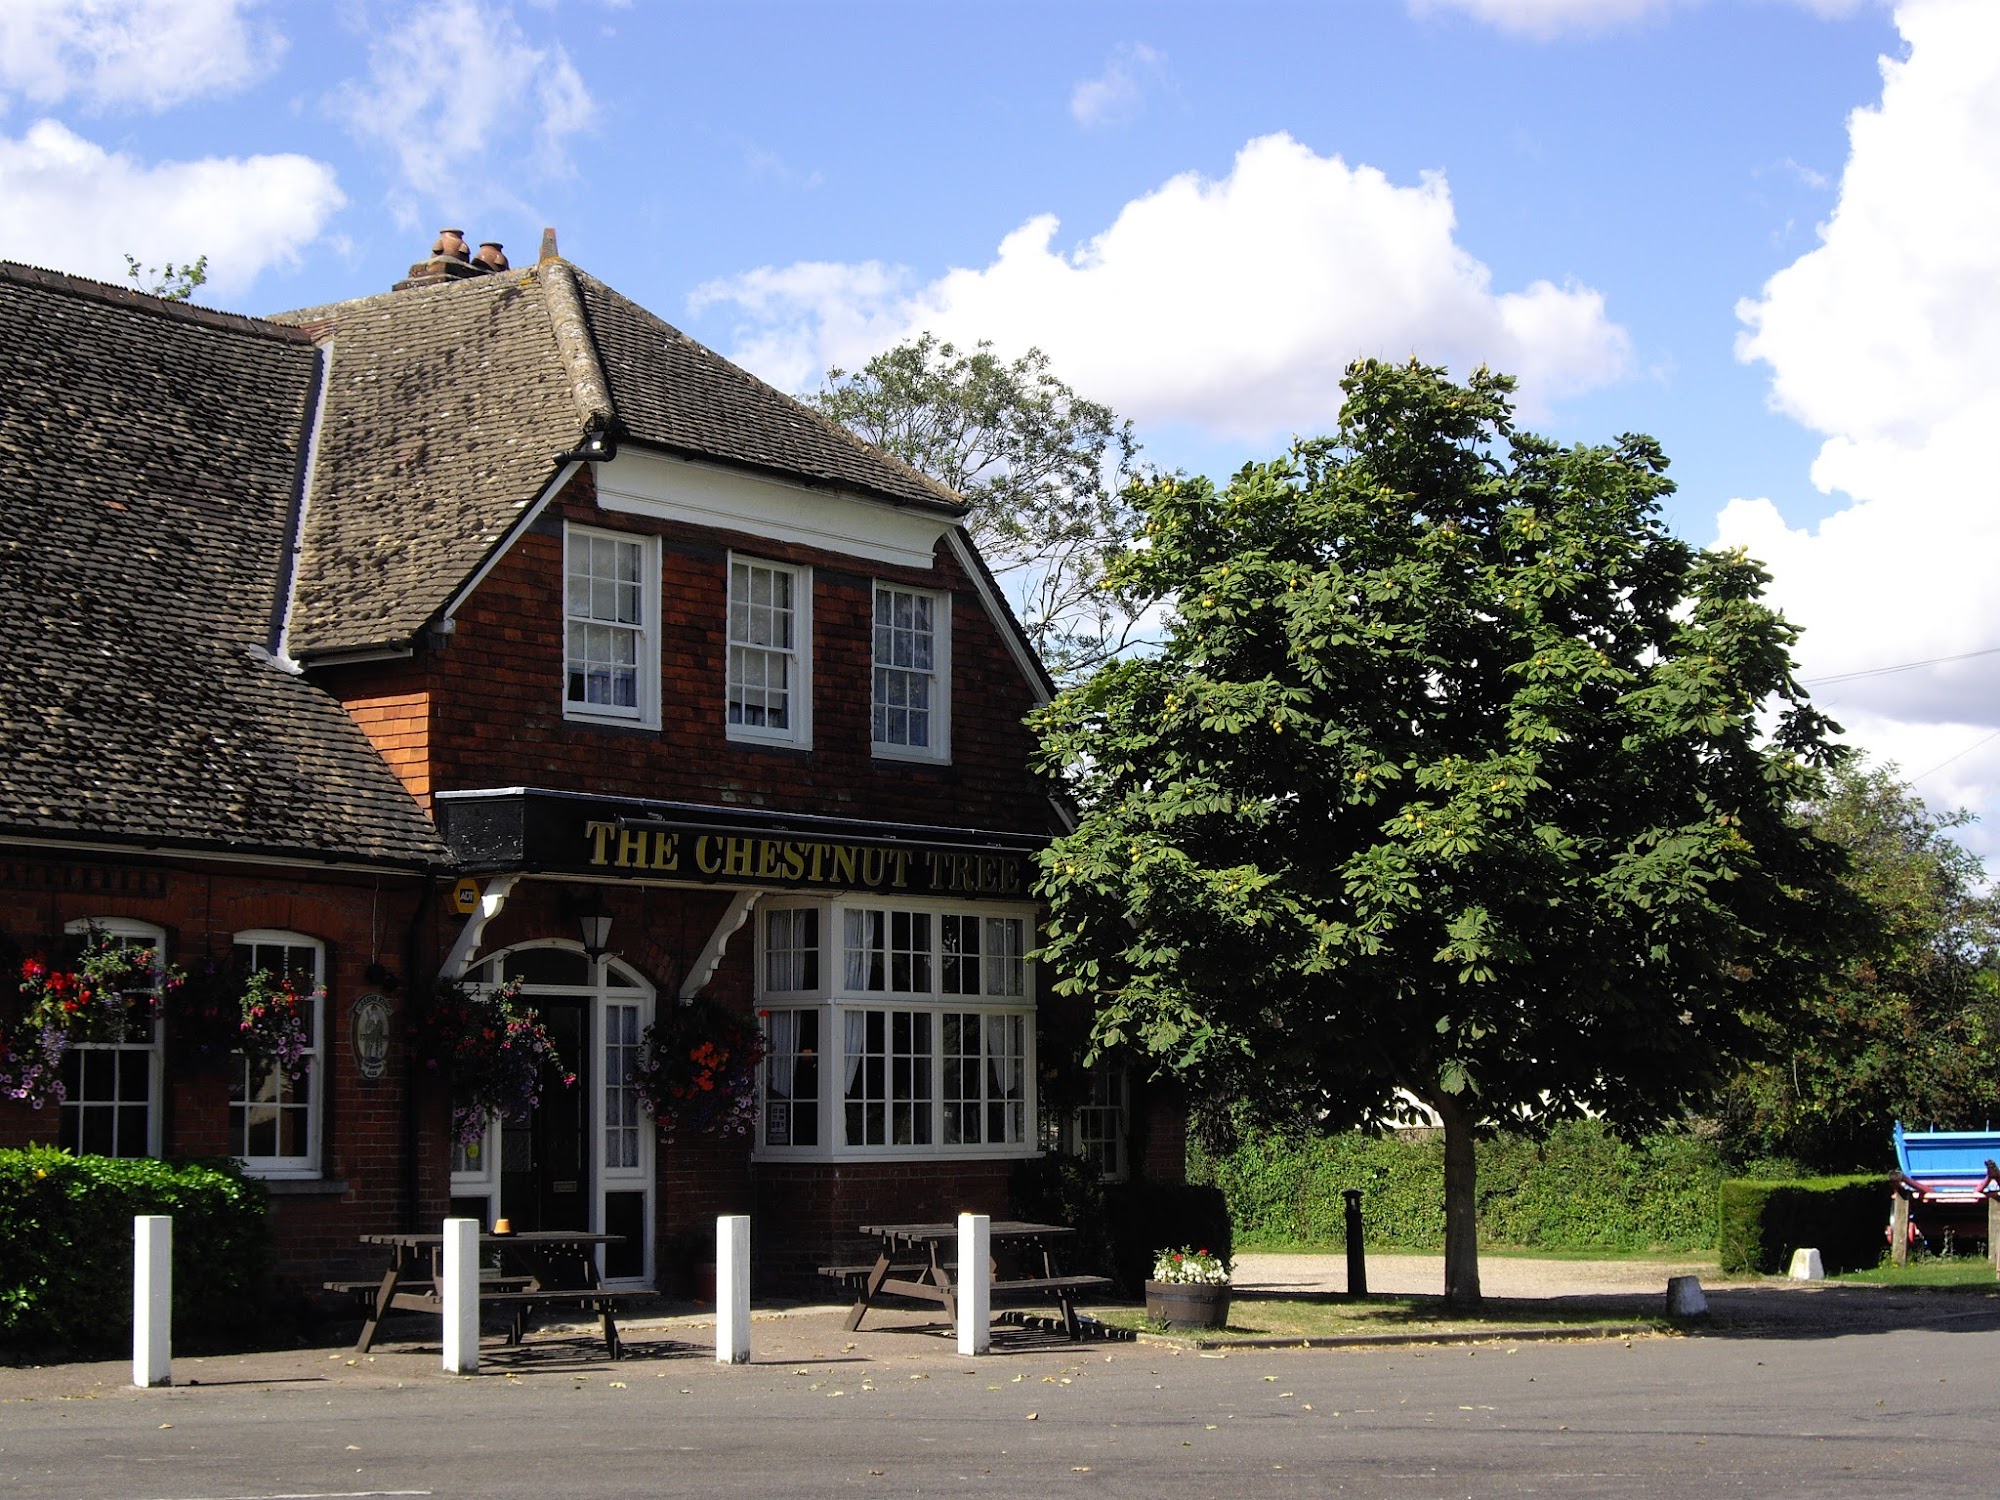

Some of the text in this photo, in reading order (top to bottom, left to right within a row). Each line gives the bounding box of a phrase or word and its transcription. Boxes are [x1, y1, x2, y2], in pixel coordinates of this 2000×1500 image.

[584, 820, 1021, 894] THE CHESTNUT TREE
[460, 891, 474, 902] ADT
